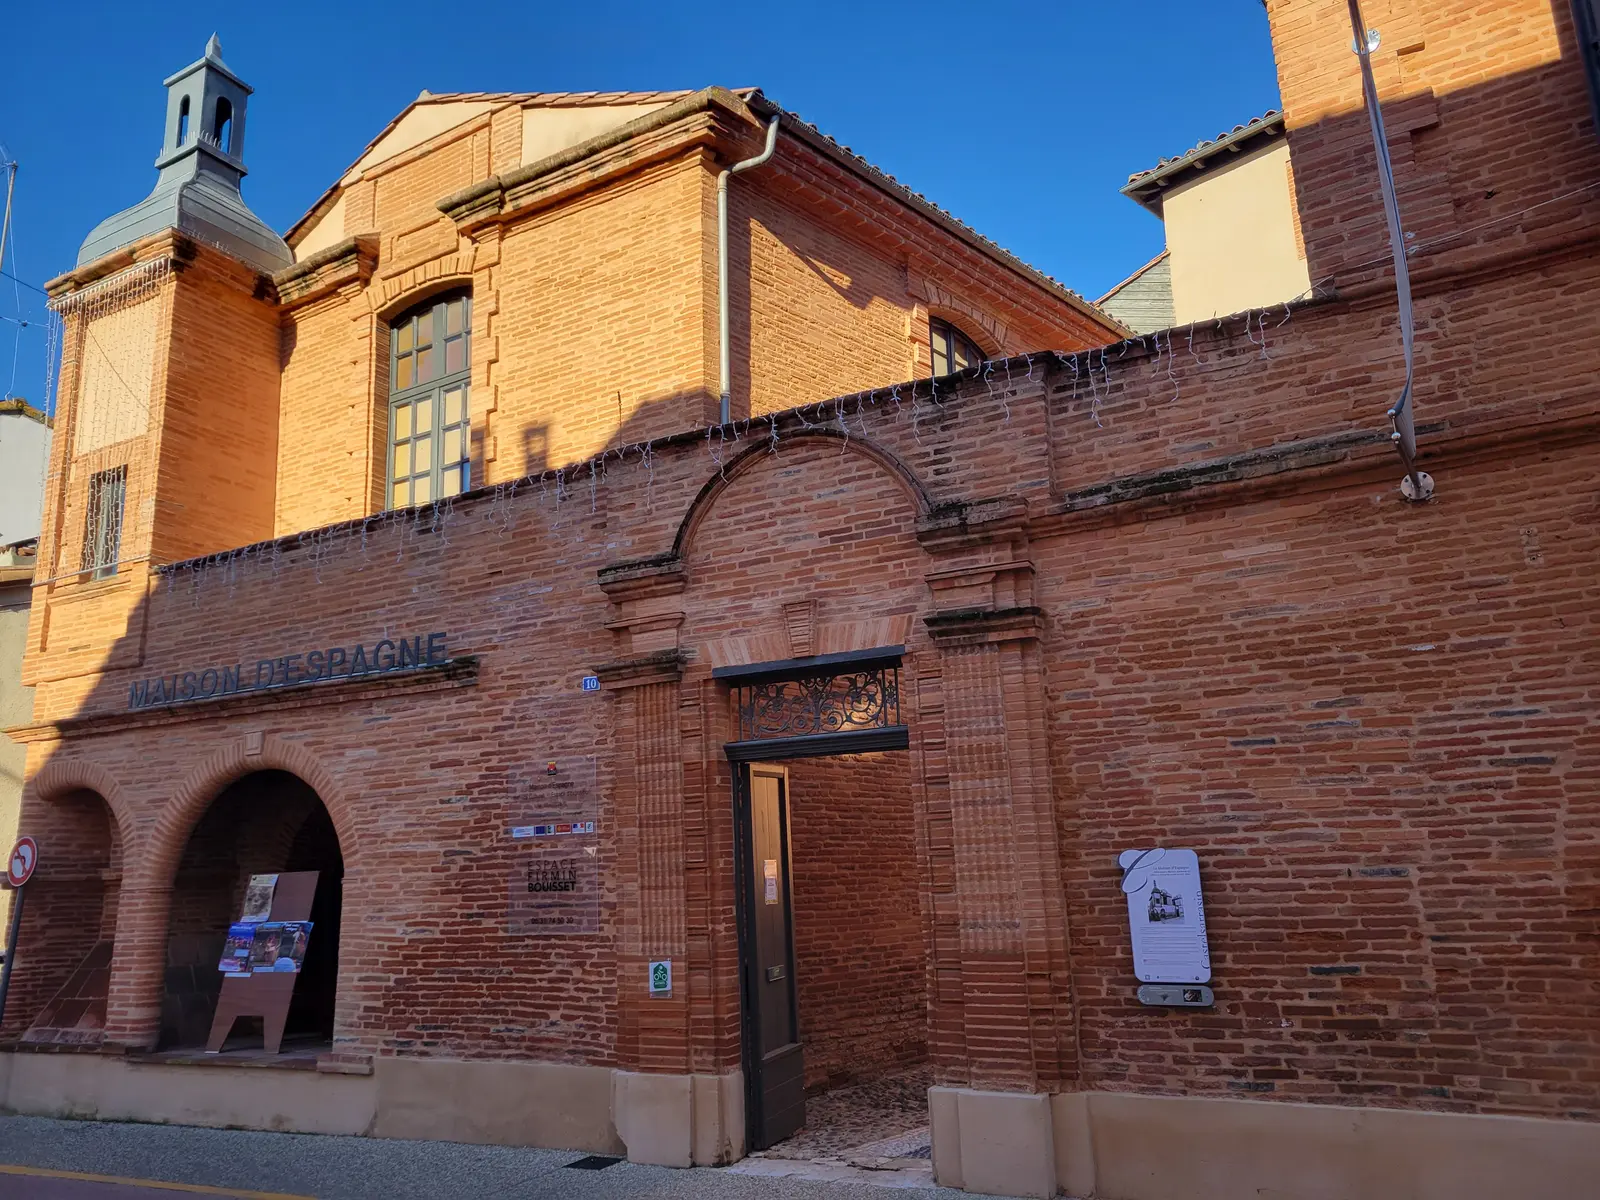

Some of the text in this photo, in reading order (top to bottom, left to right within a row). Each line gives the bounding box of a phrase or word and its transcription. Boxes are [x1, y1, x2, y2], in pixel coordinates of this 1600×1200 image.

[128, 631, 448, 710] MAISON D'ESPAGNE
[586, 679, 597, 689] 10
[528, 858, 577, 871] ESPACE
[528, 870, 577, 882] FIRMIN
[528, 880, 577, 892] BOUISSET
[1193, 890, 1210, 970] Castelsarrasin
